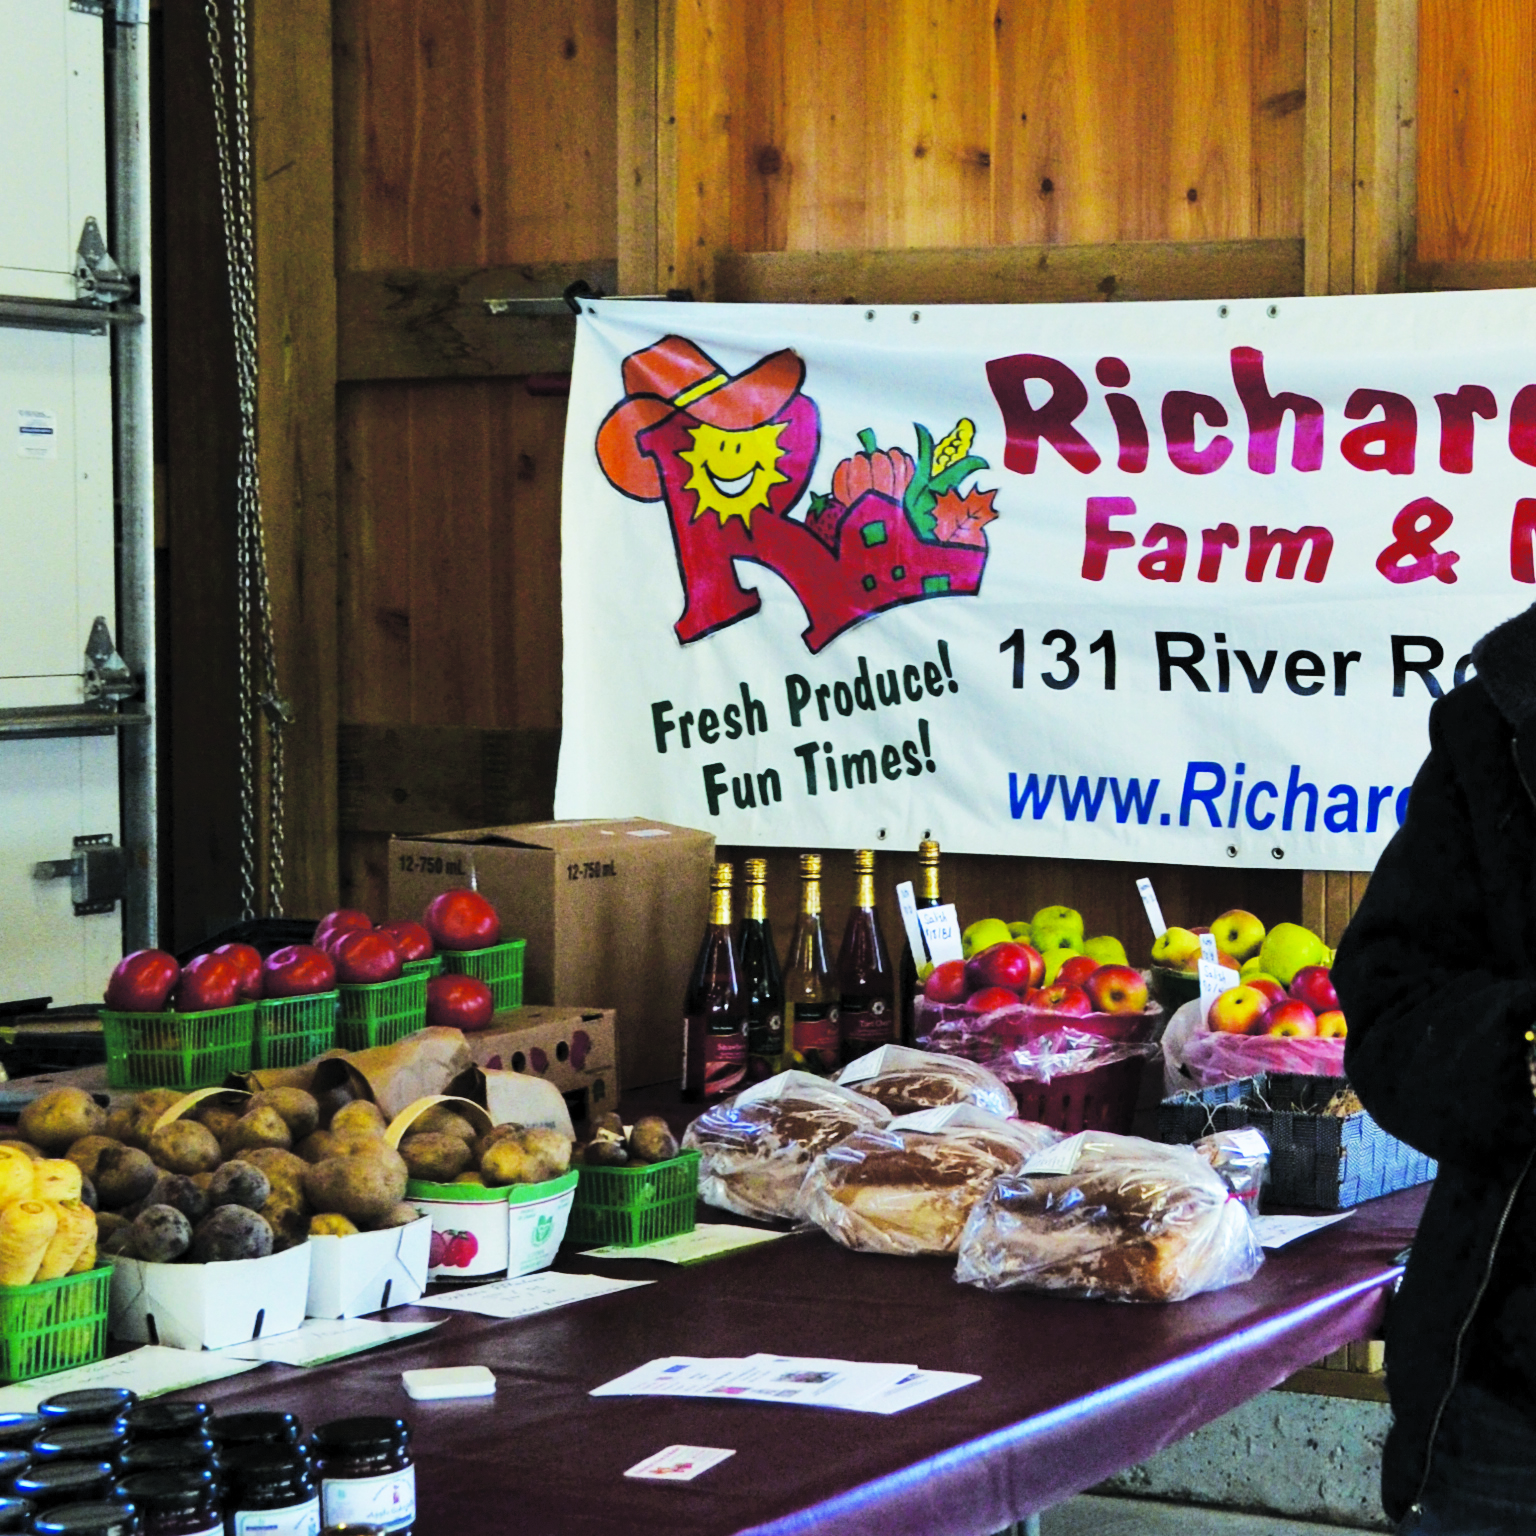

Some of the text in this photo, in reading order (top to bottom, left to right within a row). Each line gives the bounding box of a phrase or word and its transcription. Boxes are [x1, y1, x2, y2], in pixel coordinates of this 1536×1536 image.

[1080, 496, 1335, 584] Farm
[1374, 496, 1461, 585] &
[651, 639, 960, 754] Fresh Produce!
[999, 628, 1117, 691] 131
[1154, 631, 1363, 696] River
[702, 718, 937, 817] Fun Times!
